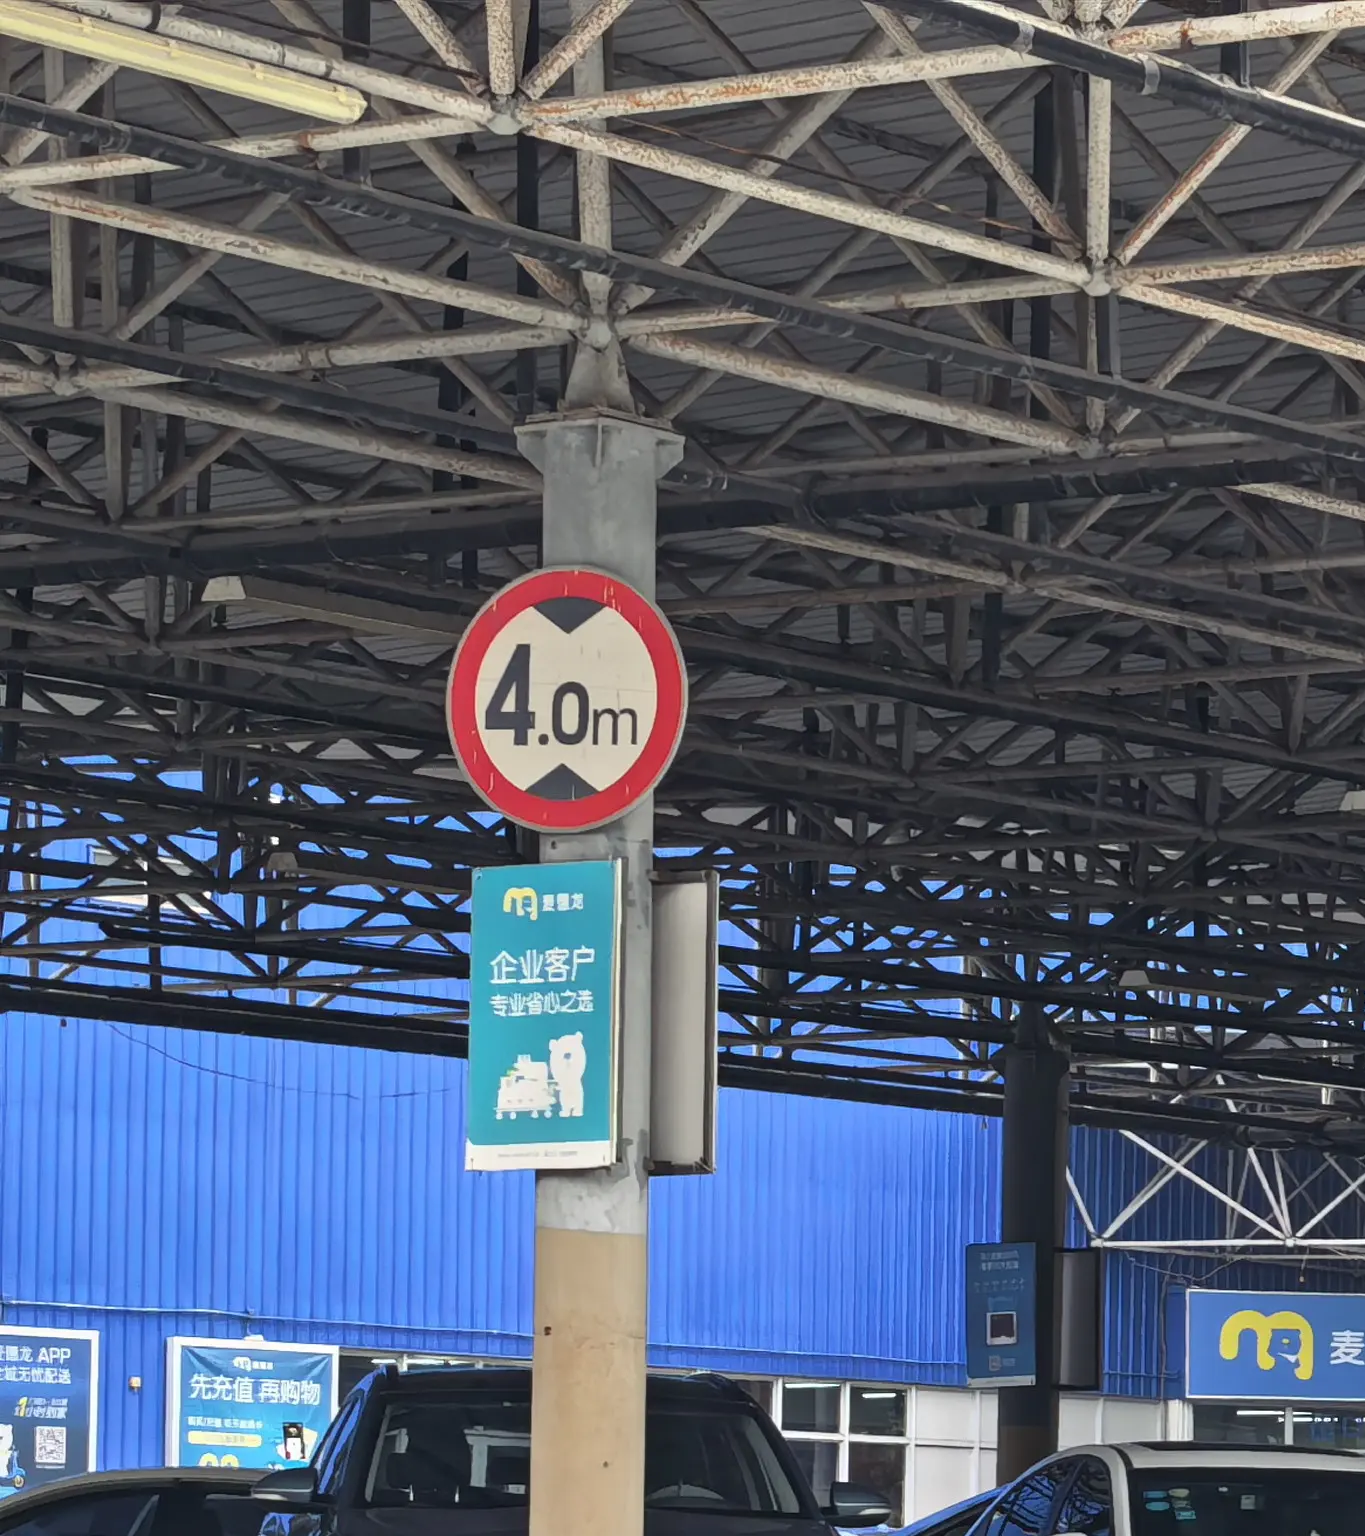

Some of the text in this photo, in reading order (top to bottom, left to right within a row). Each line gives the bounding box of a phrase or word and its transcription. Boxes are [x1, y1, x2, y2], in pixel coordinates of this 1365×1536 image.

[485, 643, 638, 746] 4.0m
[489, 945, 596, 984] 企业客户
[489, 989, 595, 1017] 专业省心之选
[37, 1347, 71, 1364] APP
[188, 1373, 322, 1406] 先充值 再购物
